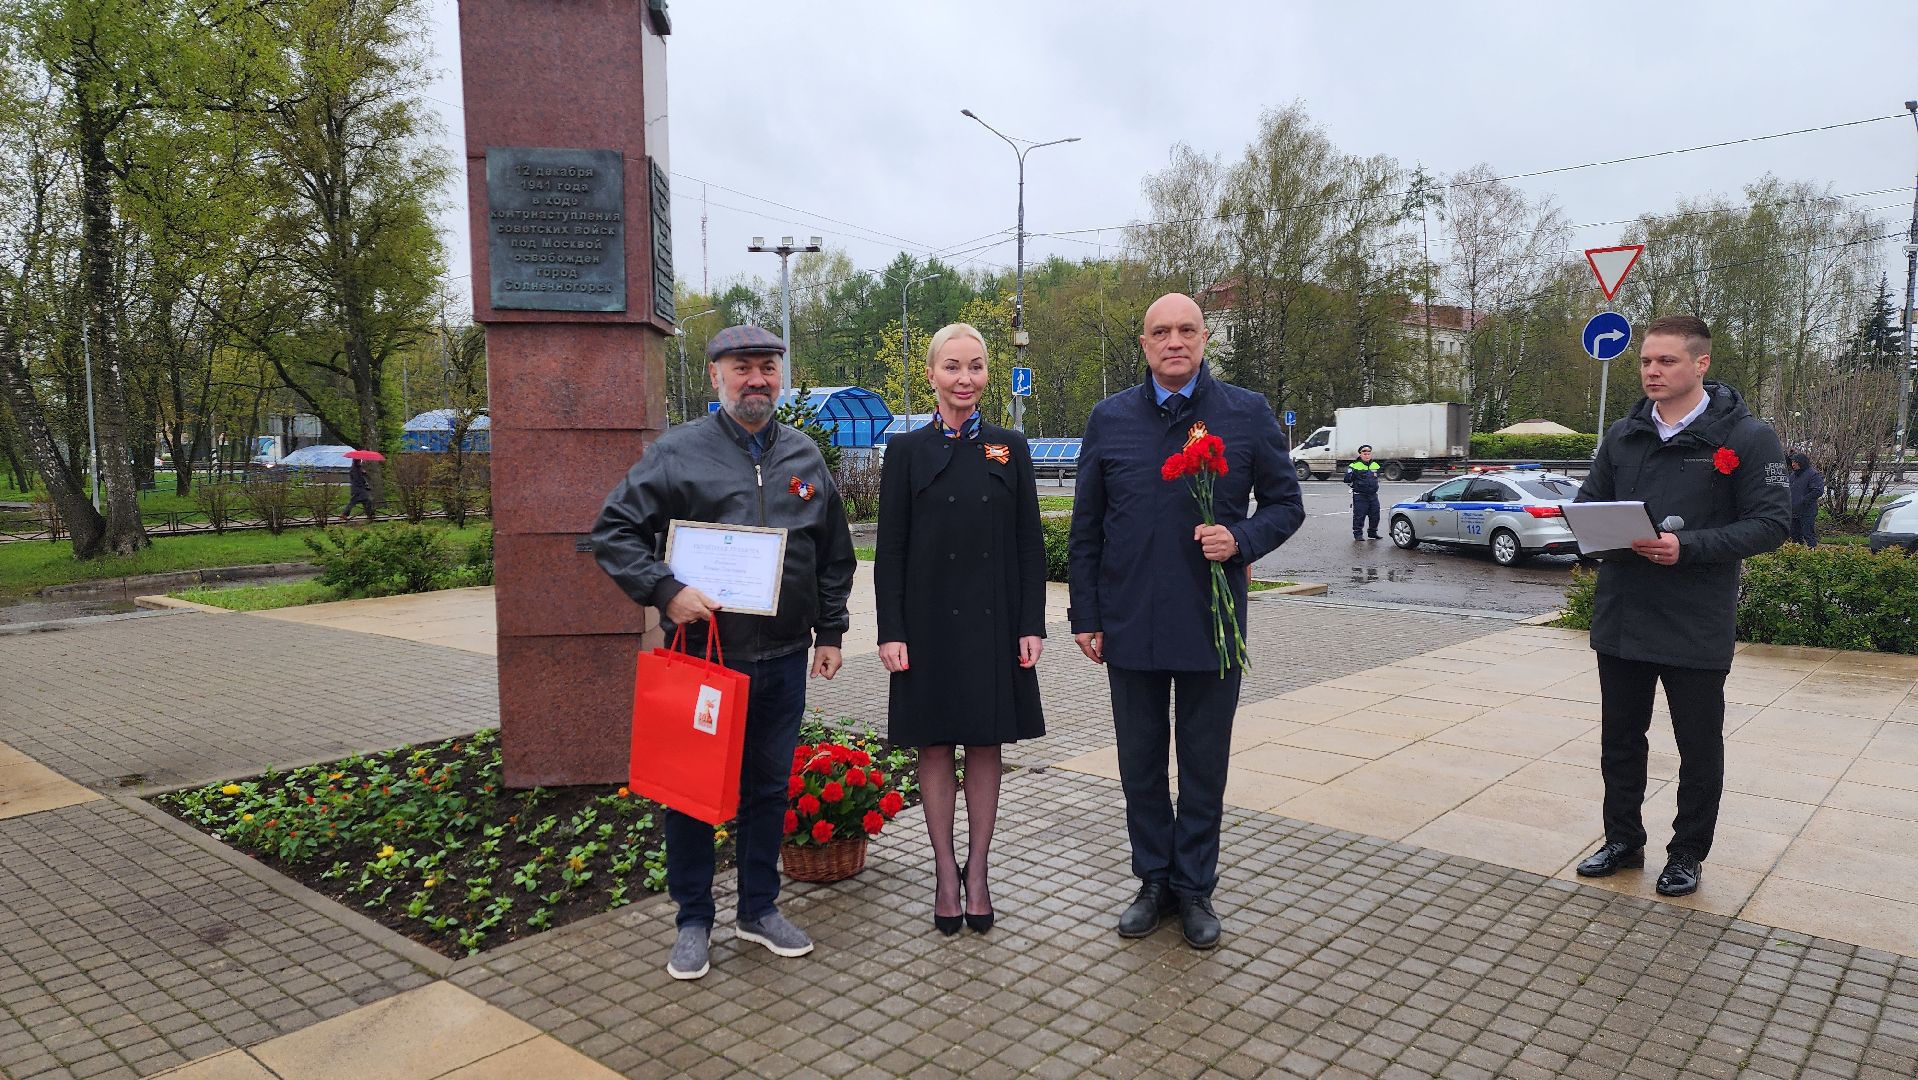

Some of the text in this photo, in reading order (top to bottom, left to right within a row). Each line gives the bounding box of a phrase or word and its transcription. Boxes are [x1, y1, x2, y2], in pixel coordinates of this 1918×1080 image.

[515, 164, 594, 178] 12 декабря
[521, 179, 590, 193] 1941 года
[533, 196, 578, 207] в ходе
[490, 209, 620, 222] контрнаступления
[497, 224, 616, 235] советских войск
[511, 238, 602, 250] под Москвой
[515, 252, 601, 265] освобожден
[536, 267, 578, 279] город
[504, 280, 613, 293] Солнечногорск
[1466, 525, 1482, 535] 112
